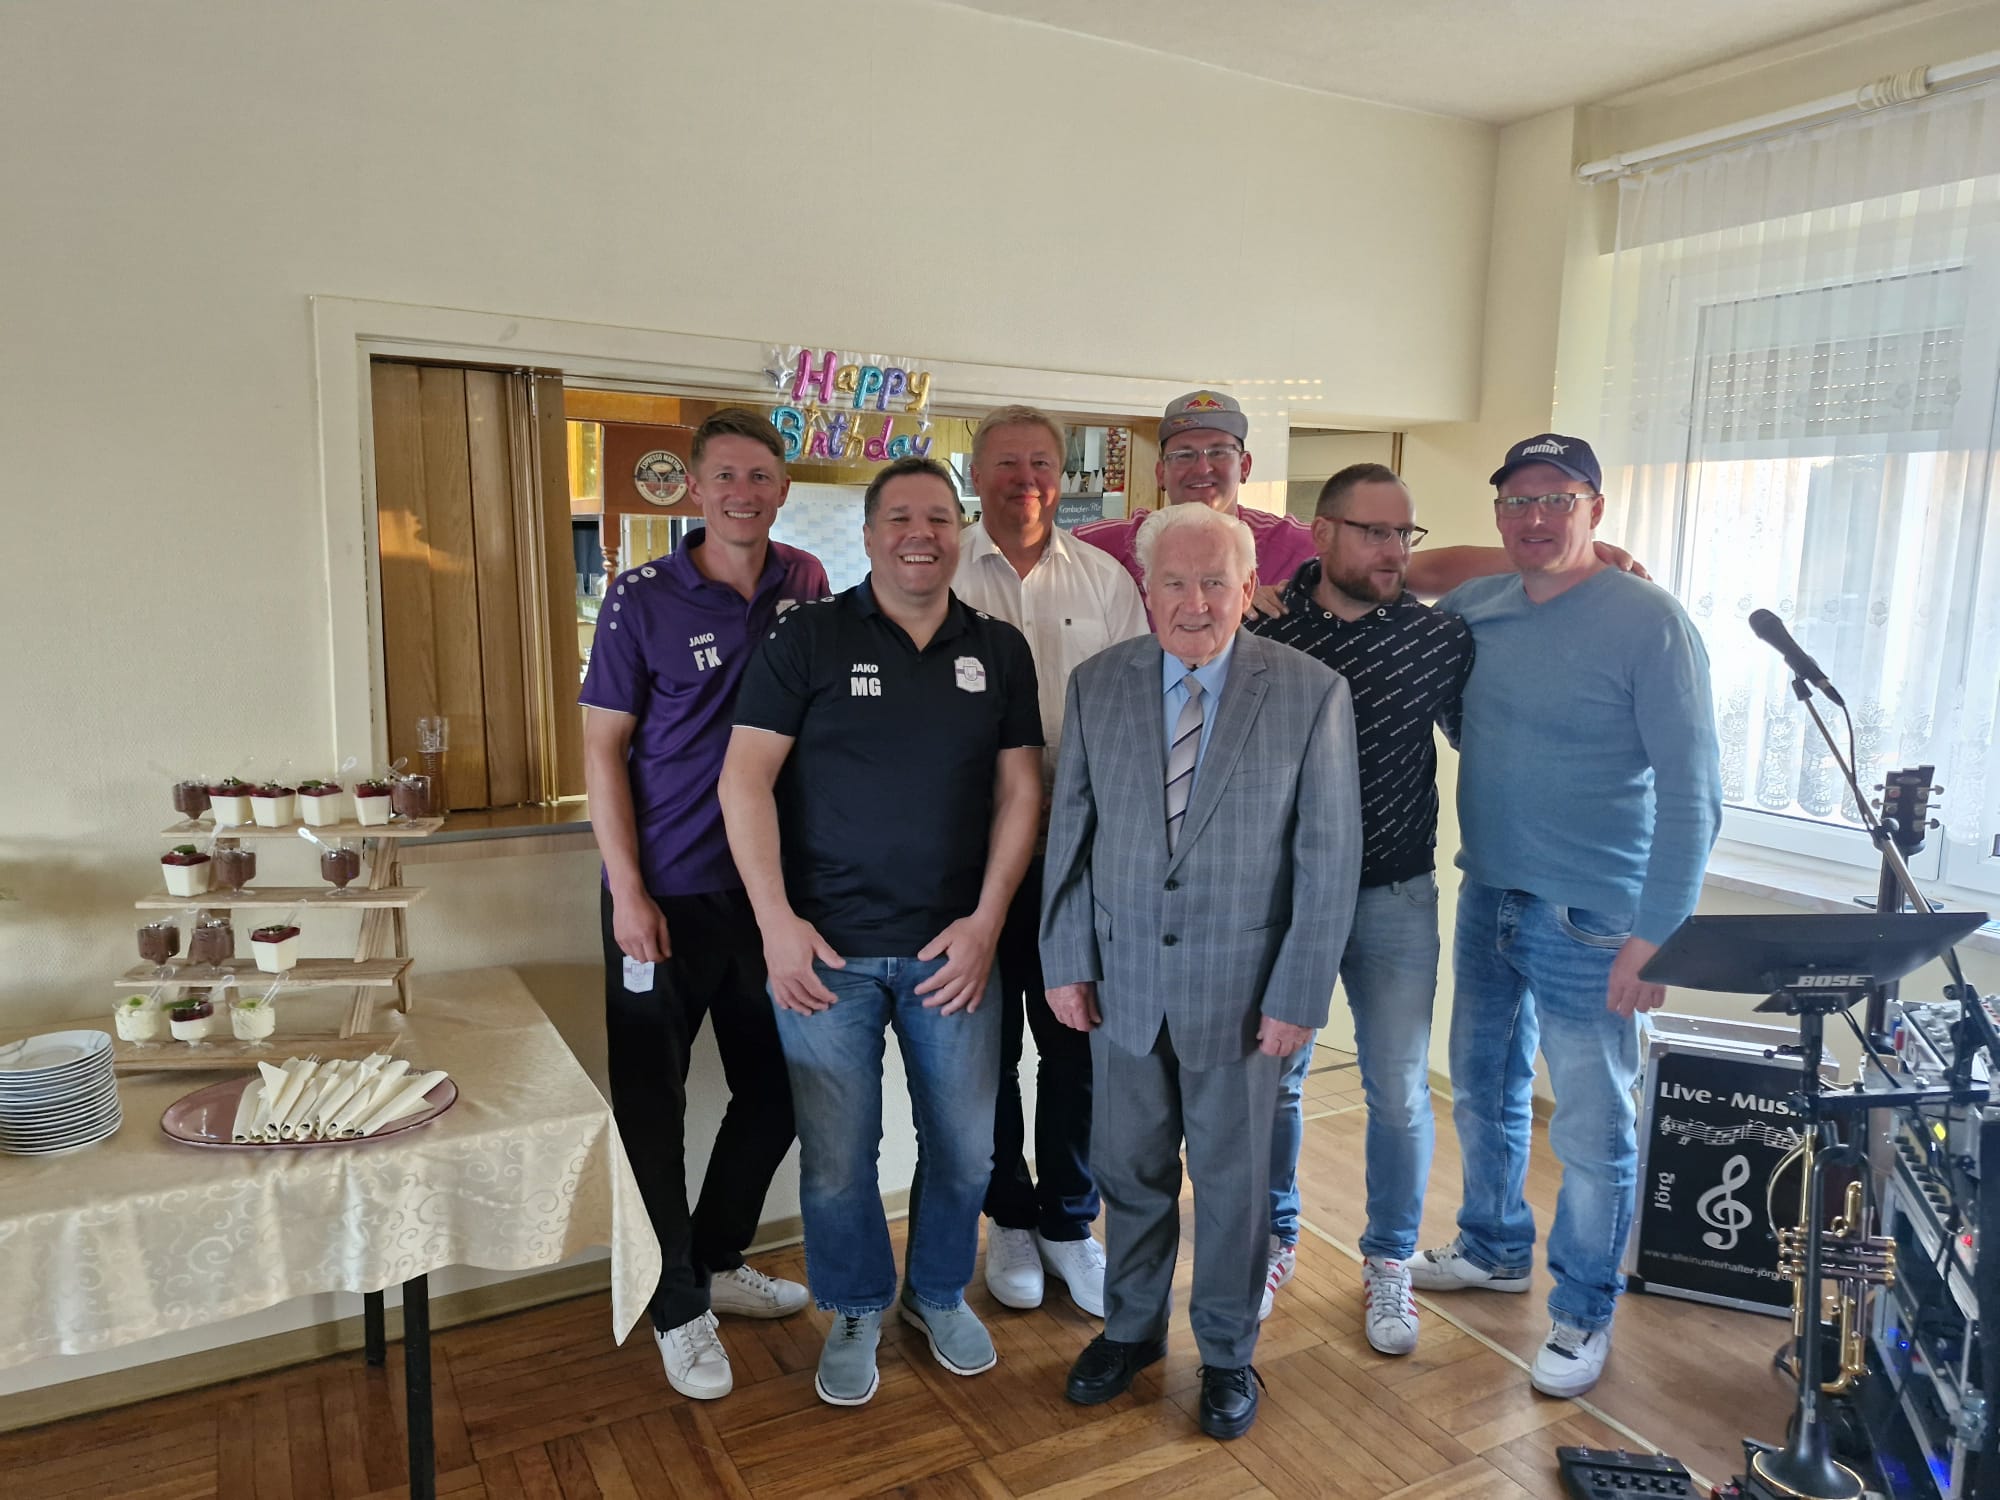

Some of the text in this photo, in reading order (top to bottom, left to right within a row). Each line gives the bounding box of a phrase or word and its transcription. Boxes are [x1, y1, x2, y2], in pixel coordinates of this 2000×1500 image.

[792, 349, 931, 411] Happy
[771, 405, 932, 461] Birthday
[1522, 444, 1558, 456] PUMA
[689, 632, 715, 647] JAKO
[693, 646, 722, 671] FK
[851, 664, 879, 673] JAKO
[851, 677, 881, 696] MG
[1790, 974, 1870, 988] BOSE
[1660, 1081, 1712, 1104] Live
[1731, 1092, 1802, 1117] Mus
[1654, 1171, 1676, 1212] Jörg
